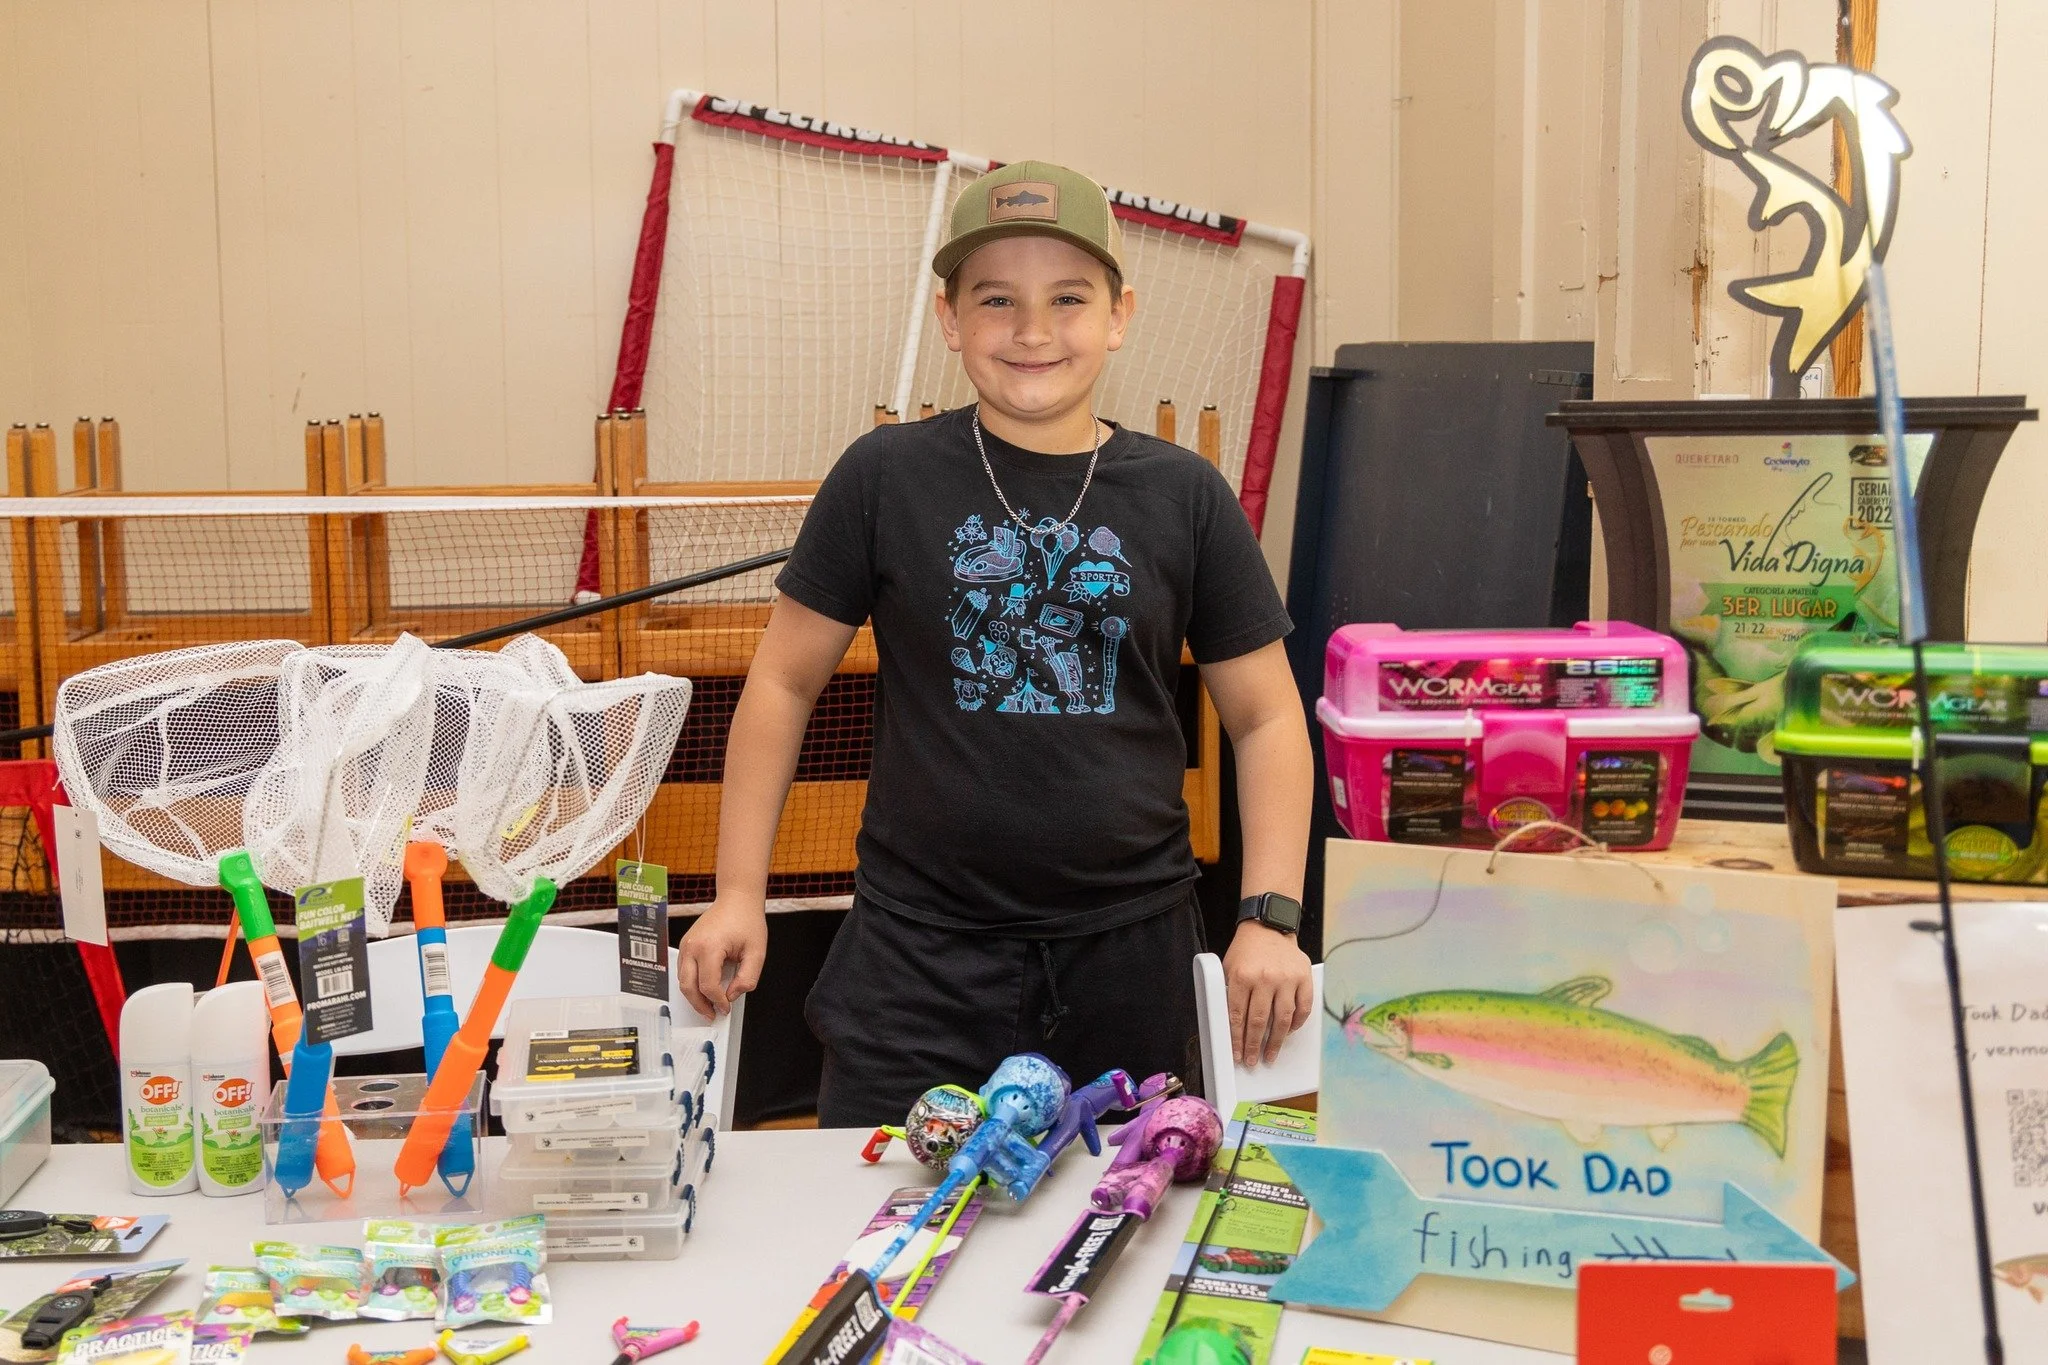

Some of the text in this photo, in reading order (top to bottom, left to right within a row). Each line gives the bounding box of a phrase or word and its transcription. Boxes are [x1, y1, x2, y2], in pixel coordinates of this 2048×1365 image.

[1858, 505, 1892, 523] 2022
[1681, 513, 1773, 538] Pescando
[1719, 538, 1865, 588] Vida Digna
[1080, 571, 1120, 583] SPORTS
[1722, 596, 1838, 619] 3ER. LUGAR
[1734, 622, 1746, 633] 21
[1752, 623, 1766, 634] 22
[1783, 634, 1802, 642] ZIMA
[618, 881, 654, 894] FUN COLOR
[1960, 1003, 2002, 1022] Took
[140, 1081, 179, 1100] OFF!
[213, 1082, 252, 1103] OFF!
[140, 1105, 182, 1113] botanicals
[214, 1105, 256, 1115] botanicals
[1430, 1140, 1673, 1196] TOOK DAD
[1231, 1183, 1306, 1202] ISHING KIT
[1244, 1180, 1290, 1194] YOUTH
[1412, 1211, 1574, 1279] fishing
[1240, 1288, 1268, 1298] PLU
[74, 1329, 176, 1358] PRACTICE
[192, 1343, 232, 1360] TICE
